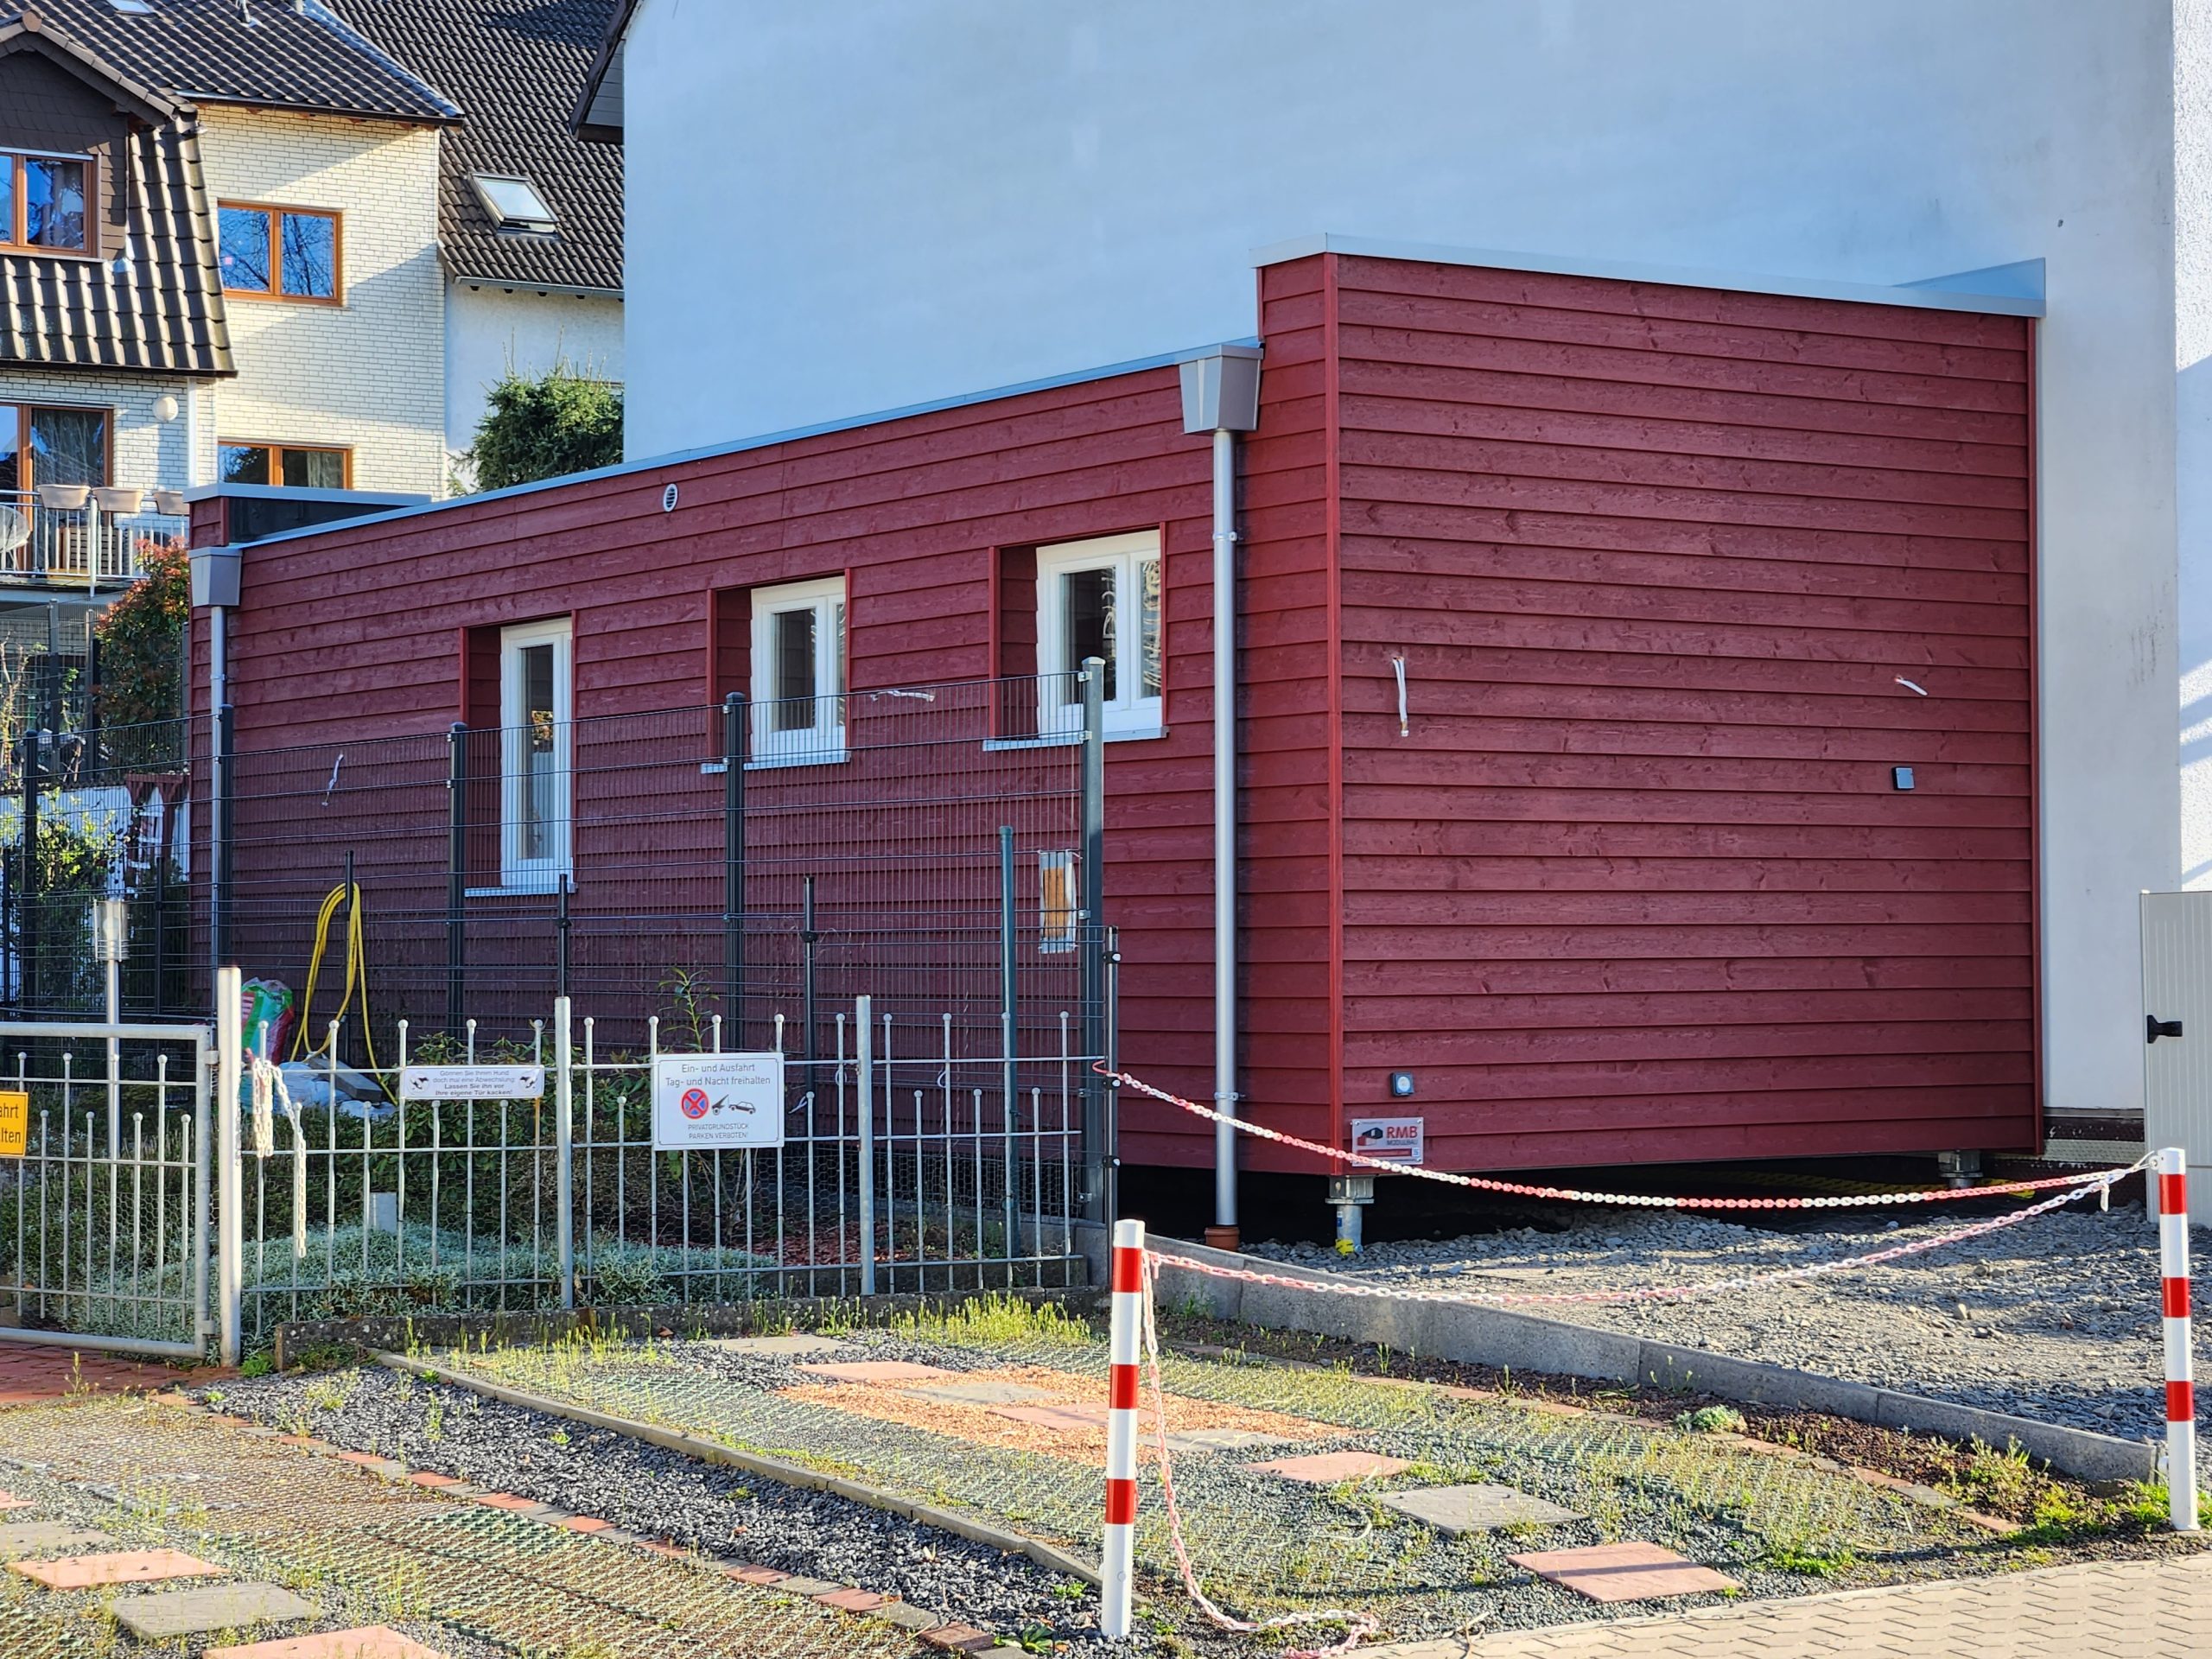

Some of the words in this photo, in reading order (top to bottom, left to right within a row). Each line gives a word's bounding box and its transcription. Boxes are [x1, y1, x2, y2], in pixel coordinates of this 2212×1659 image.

[682, 1064, 699, 1073] Ein-
[701, 1064, 717, 1072] und
[719, 1063, 755, 1072] Ausfahrt
[665, 1077, 684, 1088] Tag-
[686, 1077, 702, 1086] und
[704, 1077, 729, 1086] Nacht
[731, 1076, 771, 1085] freihalten
[0, 1103, 19, 1119] hrt
[1386, 1126, 1417, 1139] RMB
